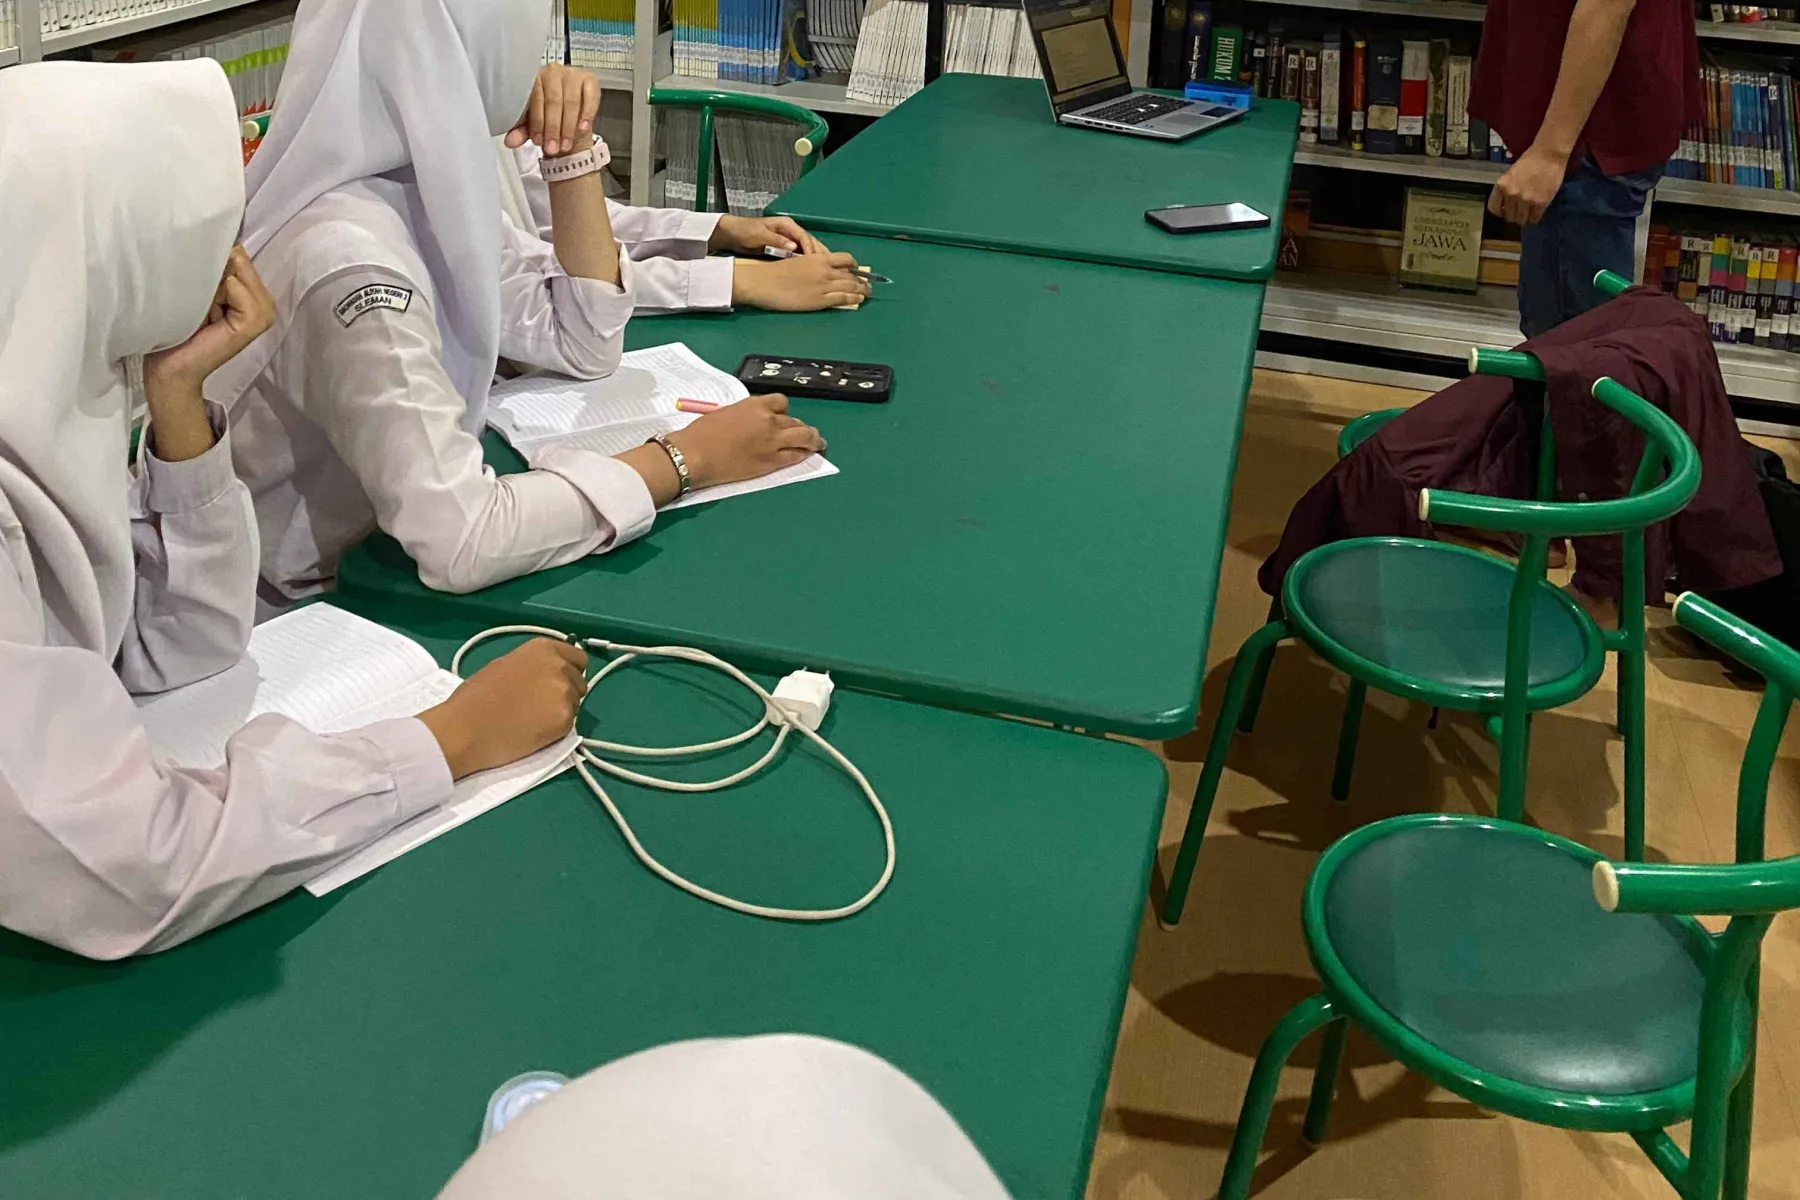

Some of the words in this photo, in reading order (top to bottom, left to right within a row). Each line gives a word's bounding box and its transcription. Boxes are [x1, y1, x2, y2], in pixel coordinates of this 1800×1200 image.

[1214, 36, 1236, 74] HUKUM
[1413, 233, 1467, 251] JAWA
[355, 296, 391, 312] SLEMAN
